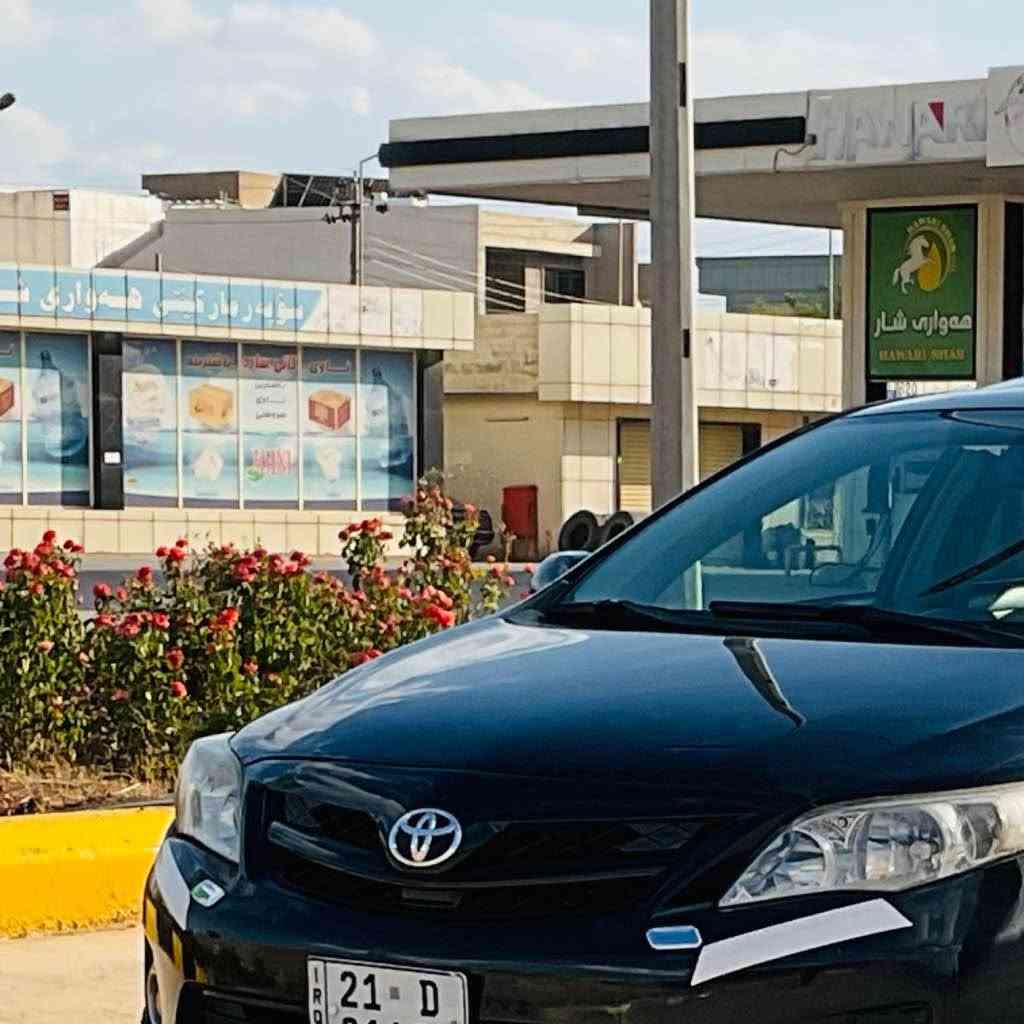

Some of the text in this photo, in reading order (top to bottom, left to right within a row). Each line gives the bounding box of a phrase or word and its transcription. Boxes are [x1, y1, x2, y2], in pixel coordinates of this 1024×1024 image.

[873, 309, 907, 338] شار
[340, 970, 439, 1018] 21 D
